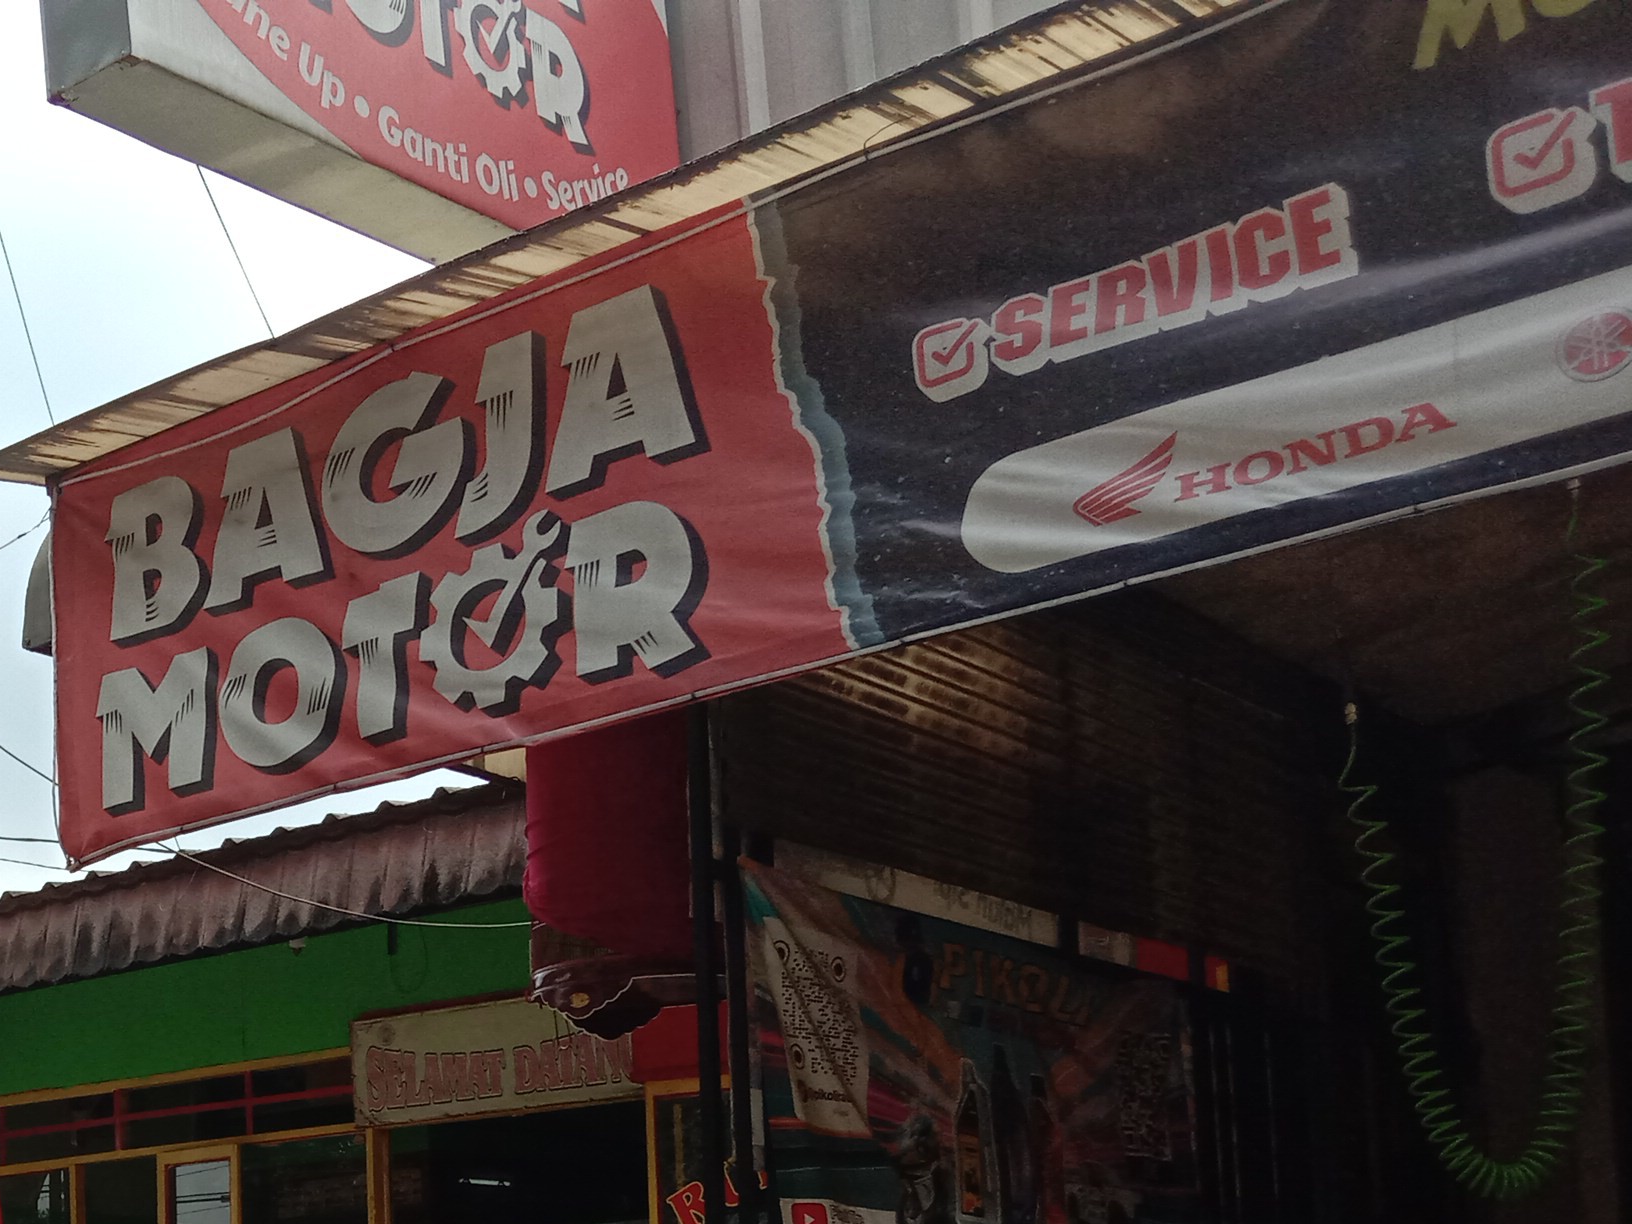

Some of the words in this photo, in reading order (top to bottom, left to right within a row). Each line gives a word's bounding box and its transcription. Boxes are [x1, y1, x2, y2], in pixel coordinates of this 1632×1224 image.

[297, 41, 345, 109] Up
[378, 105, 469, 183] Ganti
[475, 153, 519, 202] Oli
[541, 163, 628, 211] Service
[990, 186, 1350, 368] SERVICE
[105, 283, 710, 644] BAGJA
[1173, 402, 1457, 503] HONDA
[96, 501, 710, 816] MOTOR
[367, 1046, 506, 1111] SELAMAT
[513, 1032, 633, 1094] DATAN
